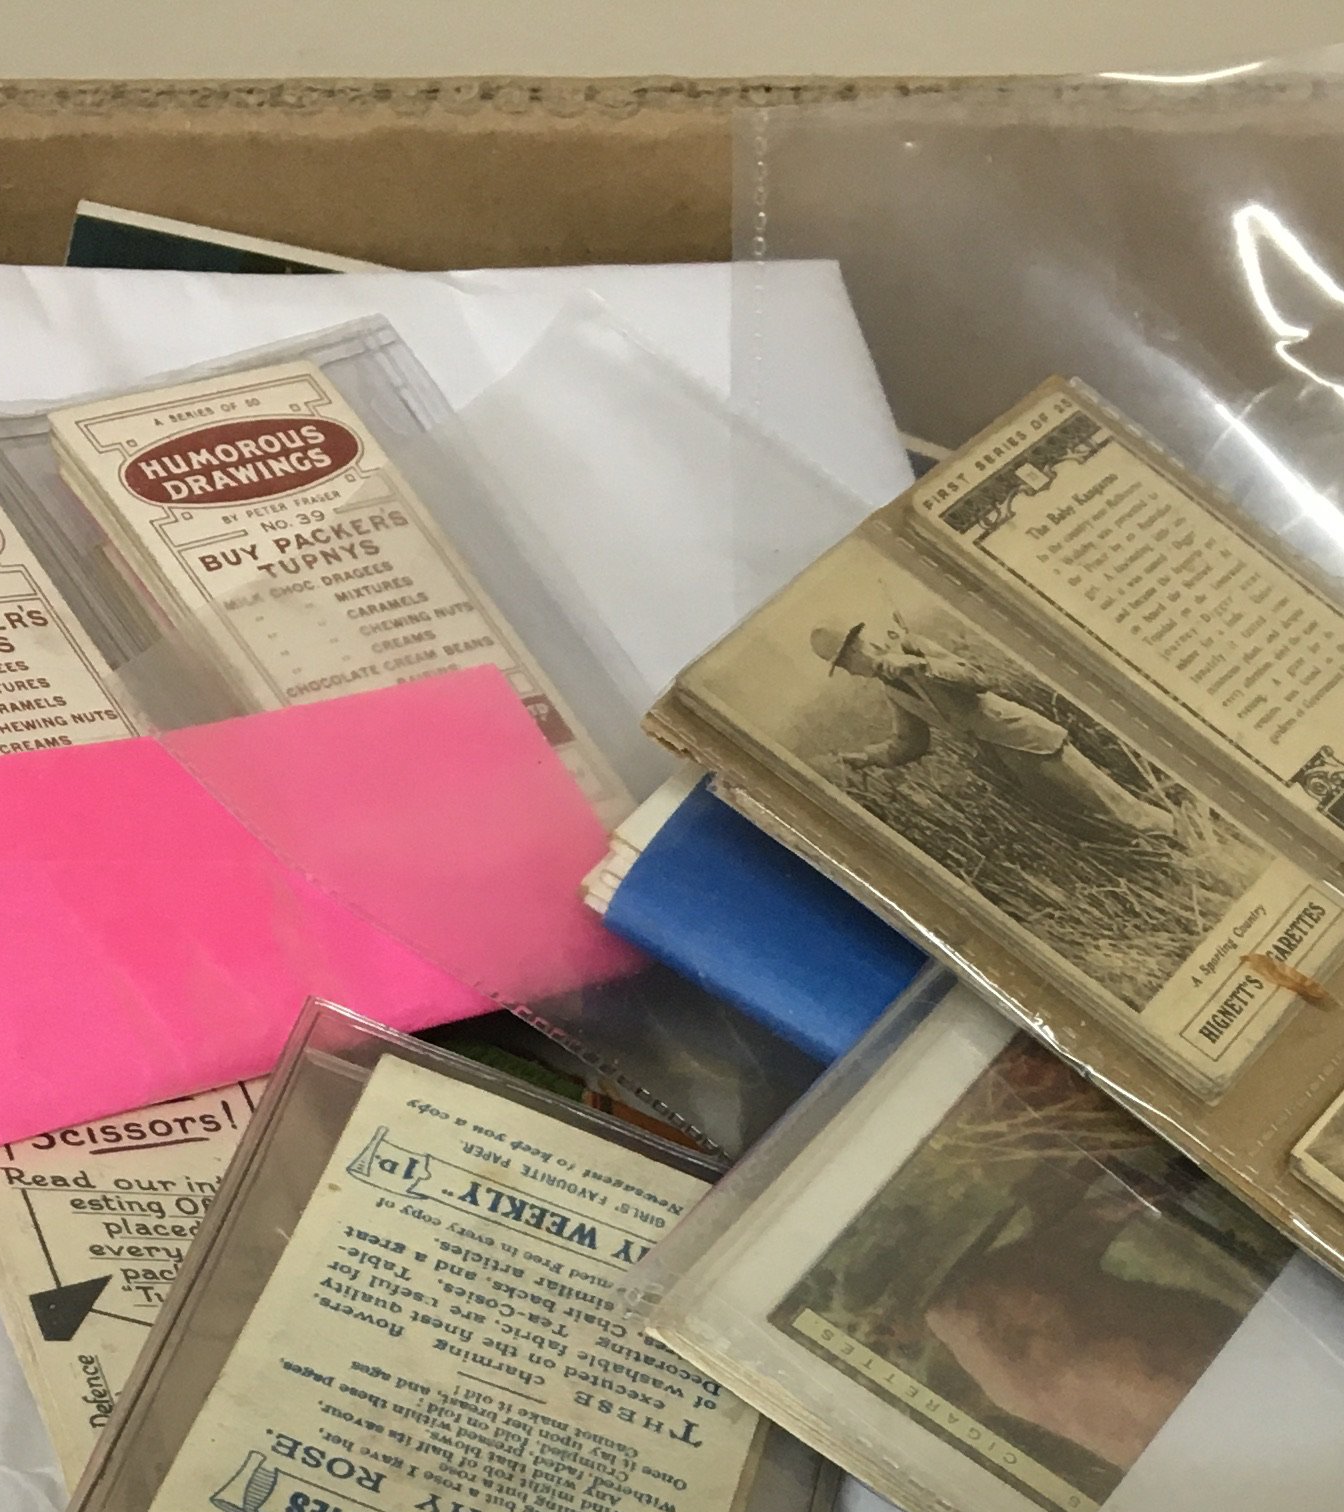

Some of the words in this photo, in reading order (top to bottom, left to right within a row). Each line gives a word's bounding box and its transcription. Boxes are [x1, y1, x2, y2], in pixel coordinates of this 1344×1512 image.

[138, 425, 327, 481] HUMOROUS
[923, 473, 971, 511] FIRST
[975, 431, 1028, 470] SERIES
[1030, 412, 1049, 431] OF
[163, 448, 333, 500] DRAWINGS
[199, 544, 258, 571] BUY
[273, 507, 410, 555] PACKER'S
[257, 539, 381, 578] TUPNYS
[334, 576, 414, 603] MIXTURES
[347, 593, 429, 619] CARAMELS
[71, 709, 118, 724] NUTS
[0, 735, 72, 755] CREAMS
[1191, 976, 1203, 988] A
[1199, 938, 1238, 976] Sporting
[1232, 904, 1267, 937] Country
[1199, 975, 1264, 1044] HIGNETT'S
[1265, 901, 1326, 962] GARETTES
[0, 1167, 95, 1189] Read
[115, 1178, 175, 1192] our
[521, 1164, 607, 1206] FAVOURITE
[70, 1196, 164, 1218] esting
[89, 1243, 183, 1263] every
[326, 1260, 359, 1282] for
[319, 1276, 402, 1316] quality
[448, 1305, 486, 1326] are
[410, 1310, 473, 1342] finest
[432, 1338, 544, 1386] charming
[481, 1337, 517, 1359] the
[526, 1353, 556, 1369] on
[593, 1336, 720, 1396] Decorating
[563, 1366, 665, 1411] executed
[577, 1350, 684, 1399] washable
[573, 1391, 702, 1448] THESE
[693, 1395, 716, 1411] of
[265, 1428, 386, 1493] ROSE.
